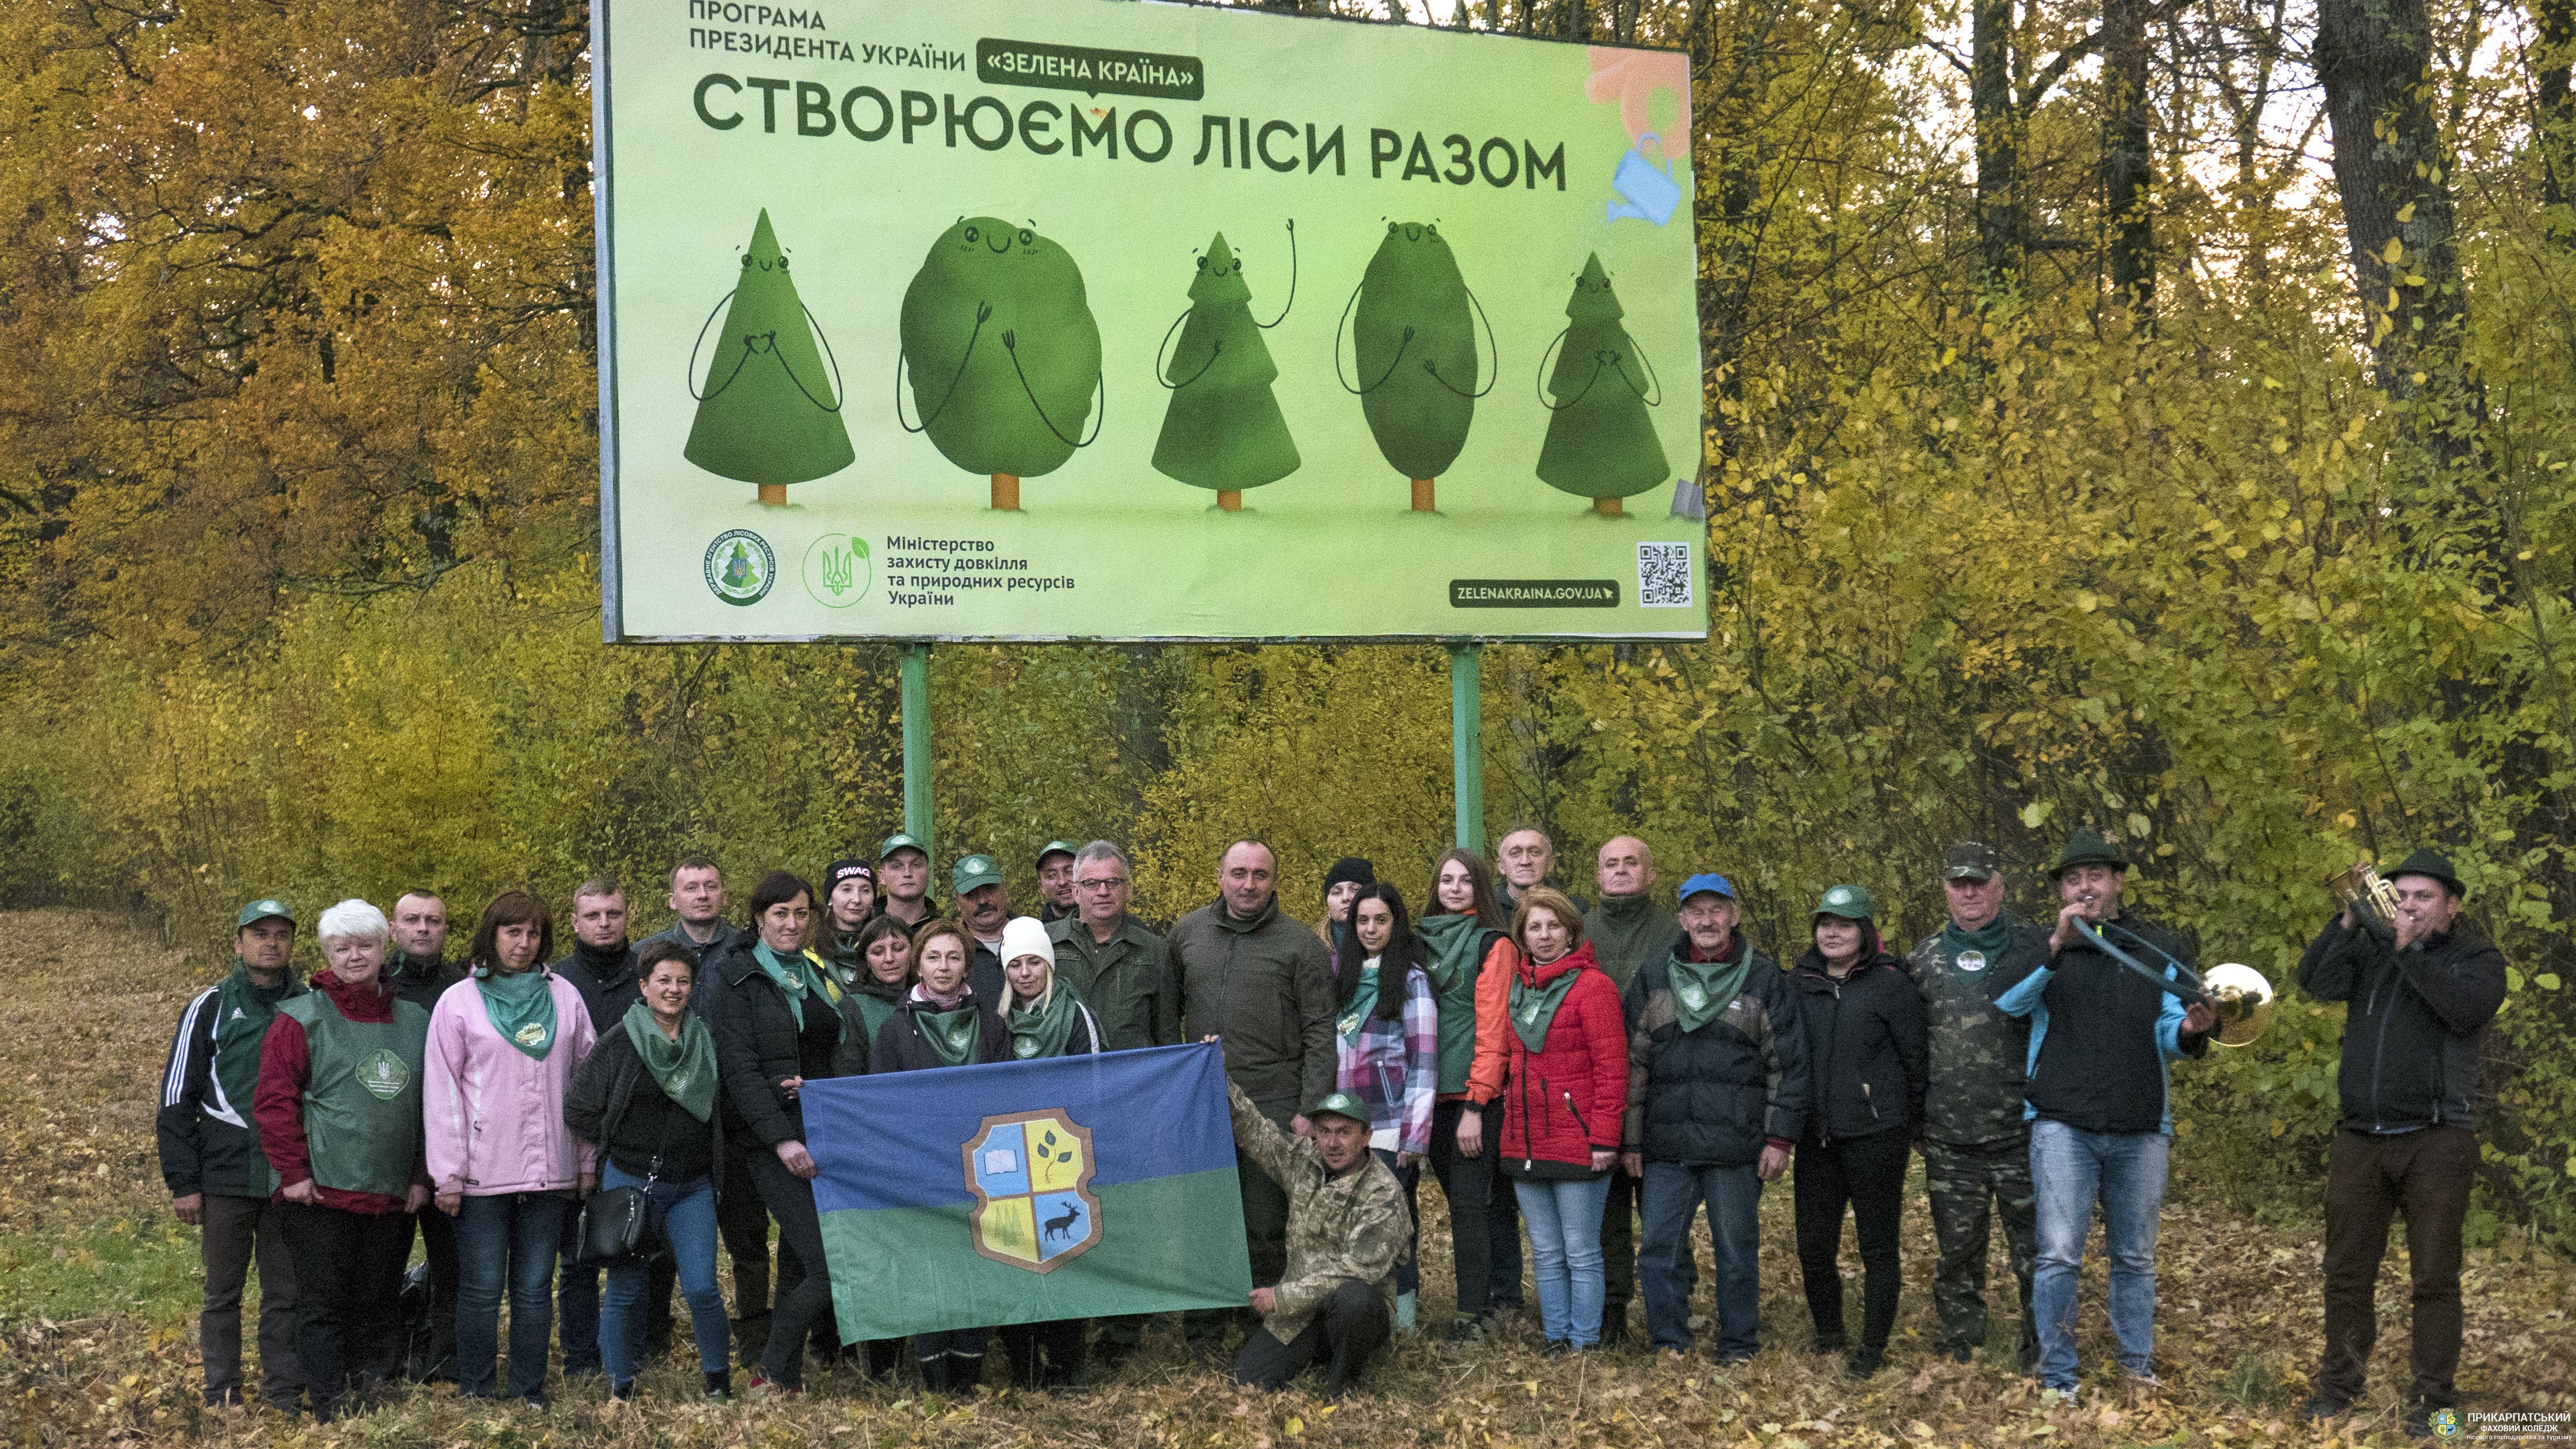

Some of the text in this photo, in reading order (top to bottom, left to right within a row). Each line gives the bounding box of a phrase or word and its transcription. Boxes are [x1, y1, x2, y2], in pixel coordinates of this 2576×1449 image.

[689, 0, 826, 30] ПРОГРАМА
[689, 28, 965, 71] ПРЕЗИДЕНТА УКРАЇНИ
[987, 52, 1194, 87] «ЗЕЛЕНА КРАЇНА»
[693, 73, 1566, 191] СТВОРЮЄМО ЛІСИ РАЗОМ
[706, 531, 733, 560] АГЕНТСТВО
[733, 530, 762, 542] ЛІСОВИХ
[887, 535, 995, 554] Міністерство
[760, 541, 775, 572] РЕСУРСІВ
[887, 557, 1028, 572] захисту довкілля
[705, 559, 723, 595] ДЕРЖАВНЕ
[887, 575, 1075, 592] та природних ресурсів
[888, 591, 954, 608] України
[1457, 587, 1603, 600] ZELENAKRAINA.GOV.UA
[837, 867, 870, 879] SWAG
